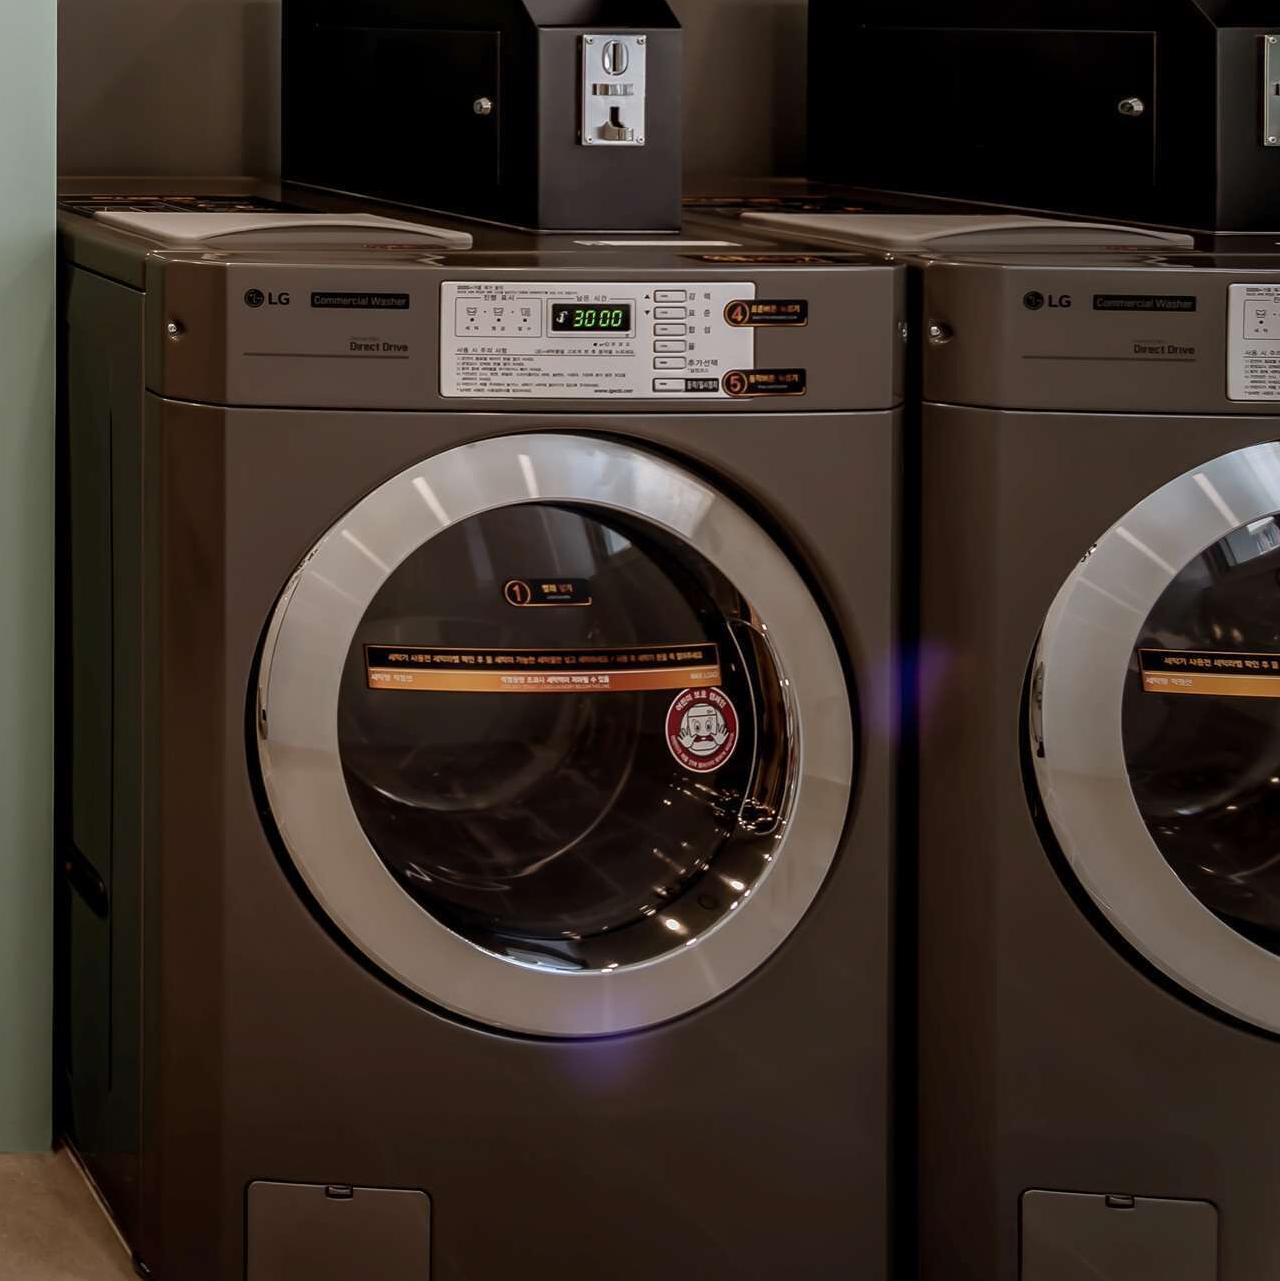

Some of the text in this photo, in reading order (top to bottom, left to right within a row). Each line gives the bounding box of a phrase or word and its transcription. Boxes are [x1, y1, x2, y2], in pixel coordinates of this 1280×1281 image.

[267, 291, 290, 306] LG
[313, 295, 407, 306] Commercial Washer
[1048, 294, 1072, 309] LG
[1096, 297, 1194, 309] Commercial Washer
[732, 306, 743, 322] 4
[349, 341, 409, 352] Direct Drive
[1133, 343, 1196, 355] Direct Drive
[688, 359, 718, 367] 추가선택
[730, 376, 742, 390] 5
[512, 584, 522, 602] 1
